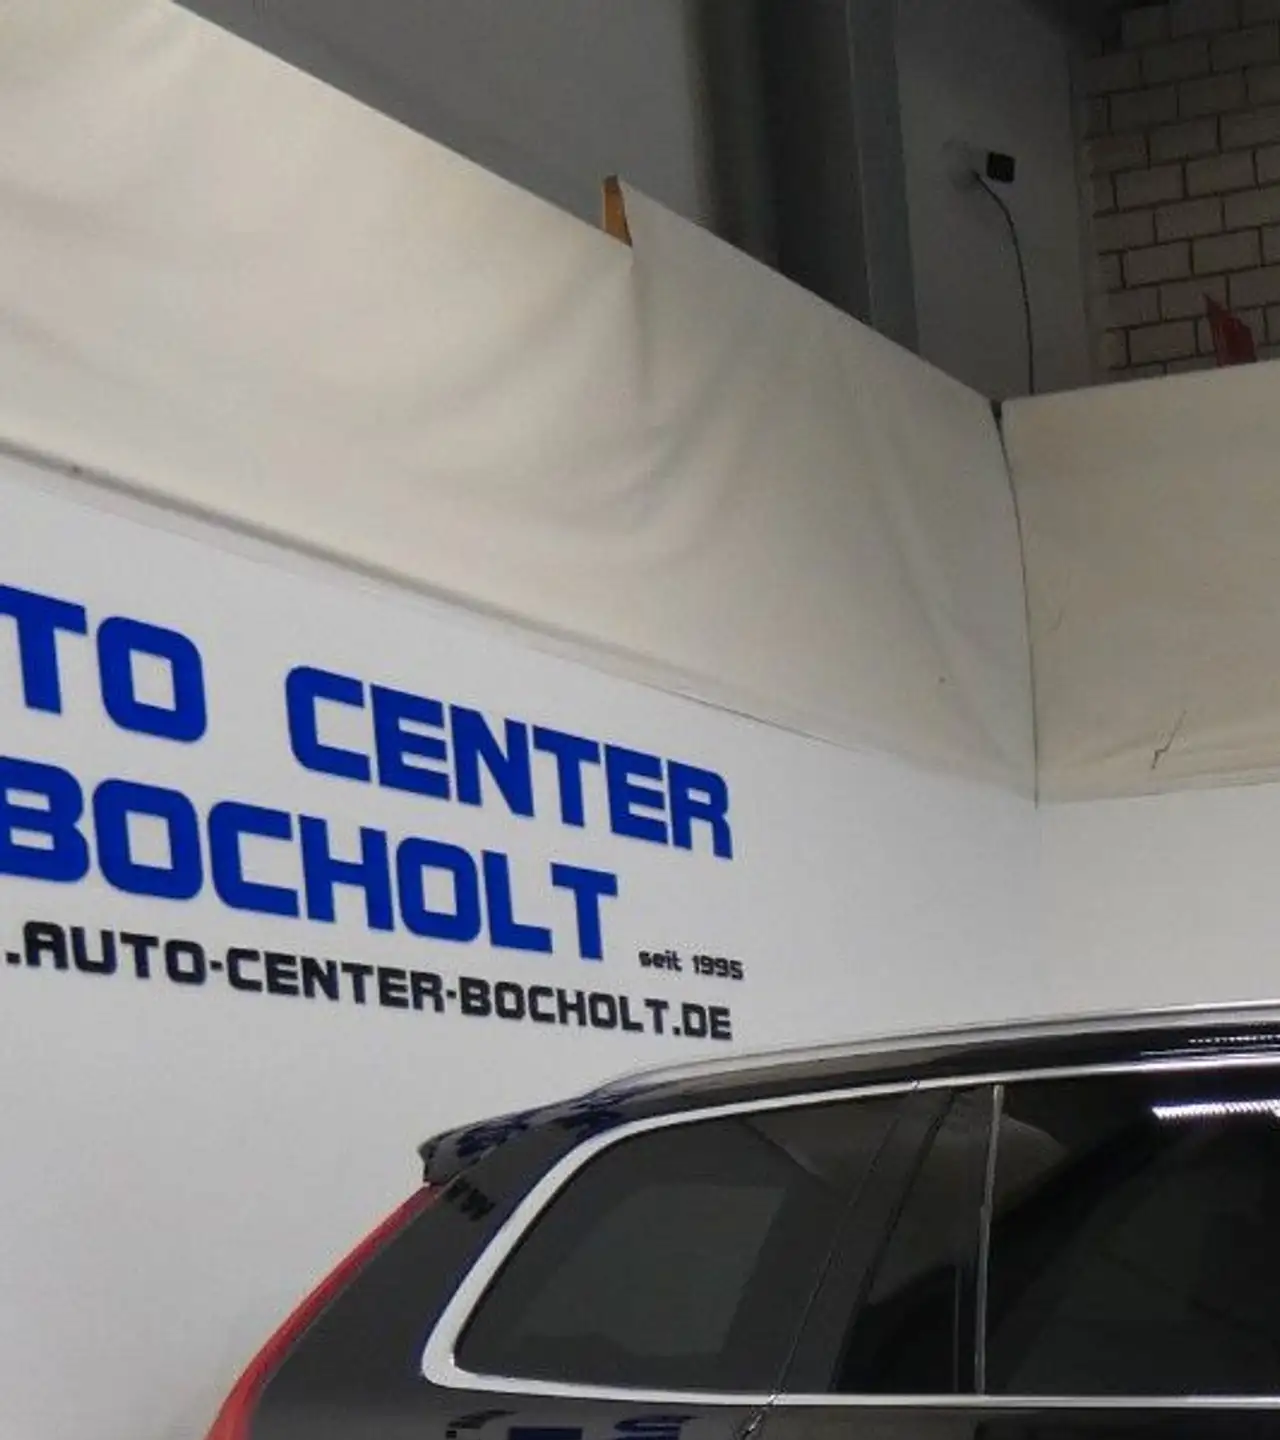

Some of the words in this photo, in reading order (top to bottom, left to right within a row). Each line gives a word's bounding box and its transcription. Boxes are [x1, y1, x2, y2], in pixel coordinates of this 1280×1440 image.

[0, 756, 619, 963] BOCHOLT
[285, 665, 734, 860] CENTER
[638, 950, 683, 973] seit
[691, 954, 745, 981] 1995
